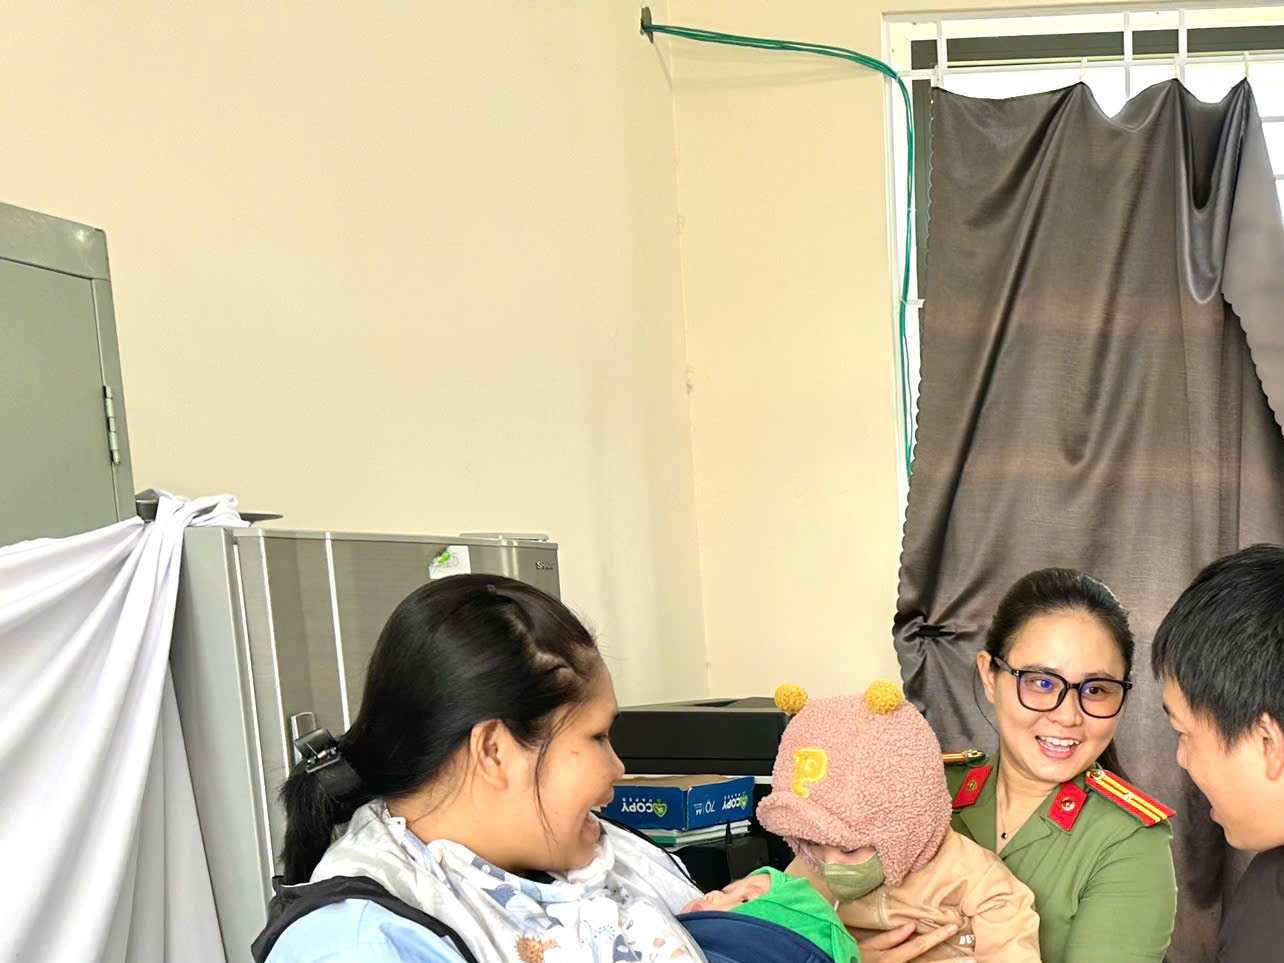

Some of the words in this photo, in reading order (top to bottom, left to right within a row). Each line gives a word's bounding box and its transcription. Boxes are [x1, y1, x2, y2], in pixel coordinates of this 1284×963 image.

[792, 747, 829, 798] P
[621, 802, 654, 813] COPY
[721, 797, 741, 811] COPY
